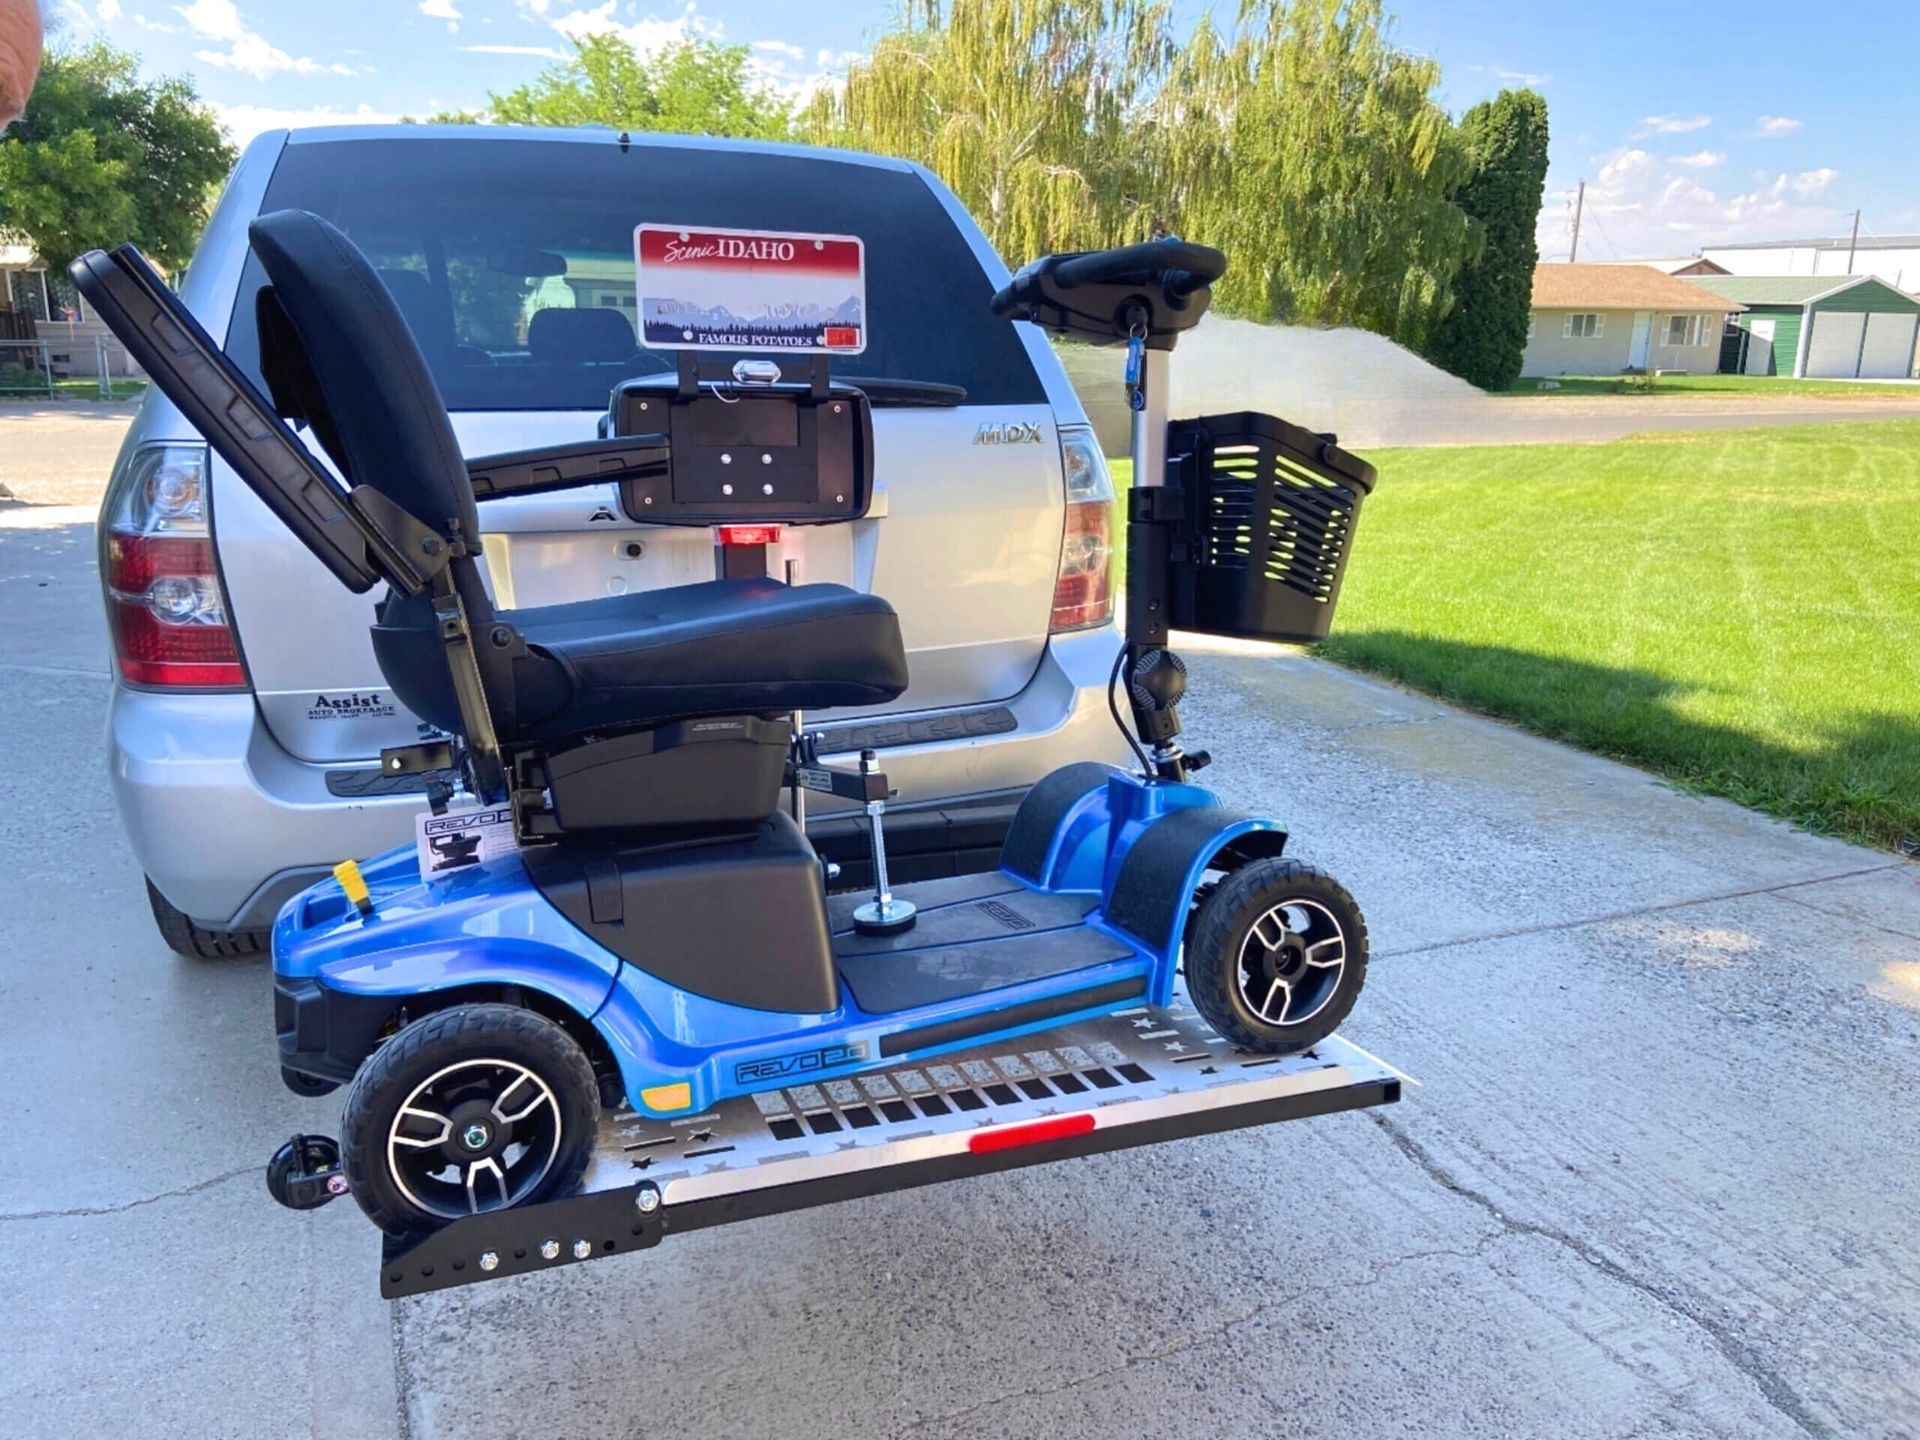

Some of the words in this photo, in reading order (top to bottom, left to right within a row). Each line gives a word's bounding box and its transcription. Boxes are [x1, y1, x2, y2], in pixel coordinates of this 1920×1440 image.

[663, 240, 717, 263] Scenic
[716, 238, 795, 261] IDAHO
[698, 333, 749, 345] FAMOUS
[751, 334, 813, 346] POTATOES
[315, 693, 381, 708] Assist
[337, 706, 394, 715] BROKERAGE
[429, 813, 496, 832] REVO
[739, 1053, 818, 1081] REVO
